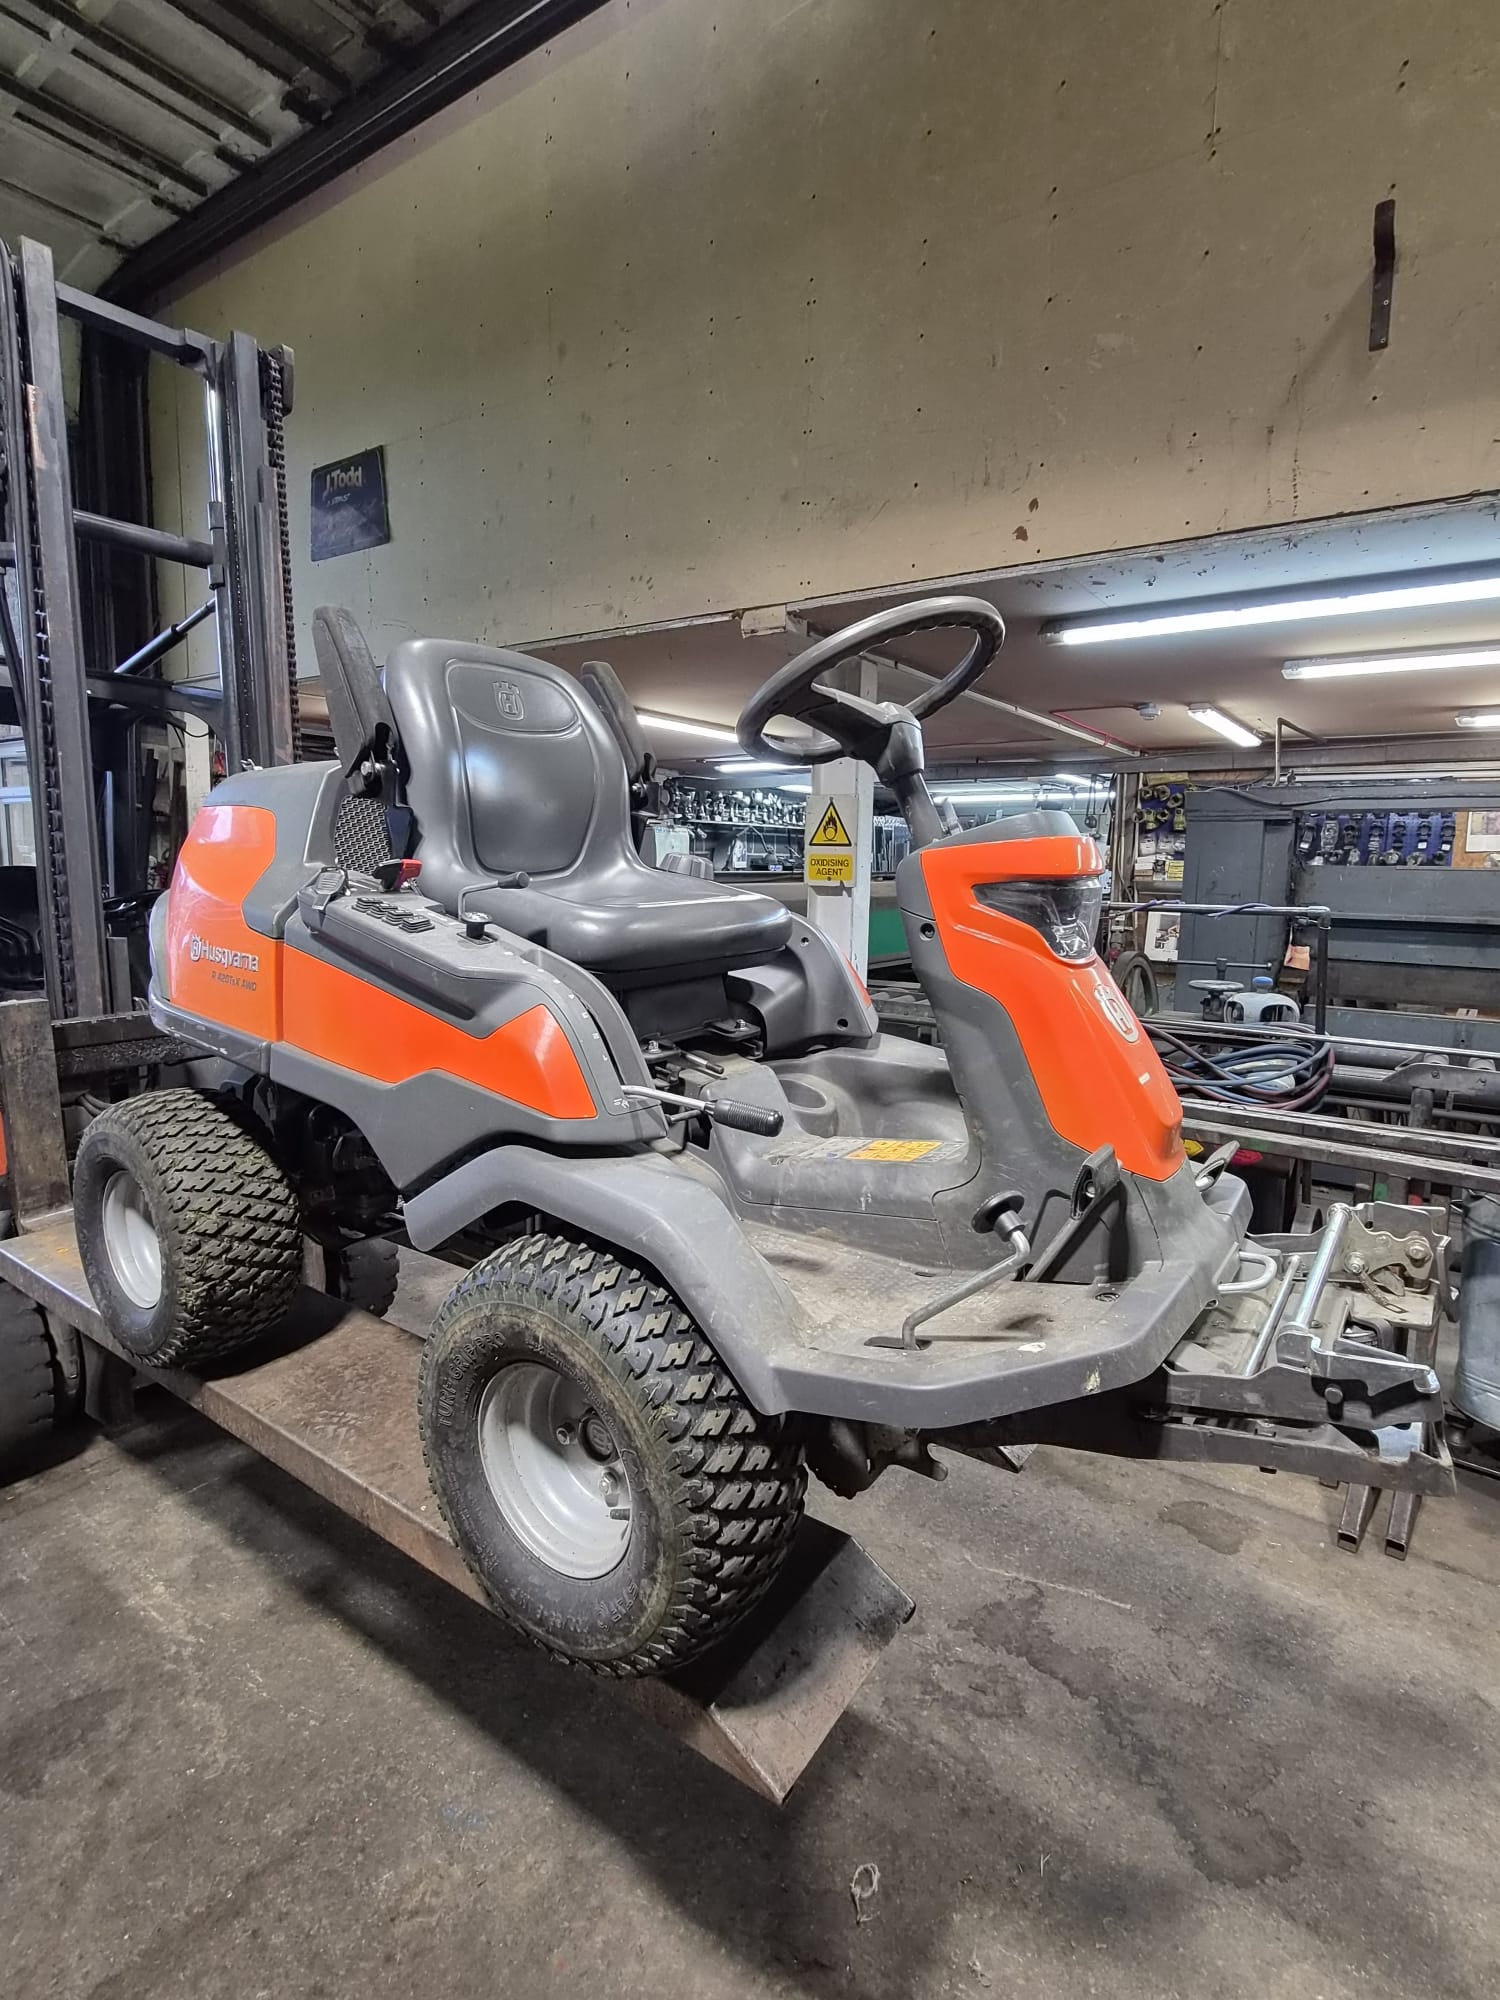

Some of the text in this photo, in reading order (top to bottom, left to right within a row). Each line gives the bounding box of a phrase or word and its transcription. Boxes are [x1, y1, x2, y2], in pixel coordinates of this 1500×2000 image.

[810, 858, 849, 868] OXIDISING
[816, 867, 843, 876] AGENT
[201, 938, 259, 972] Husqvarna
